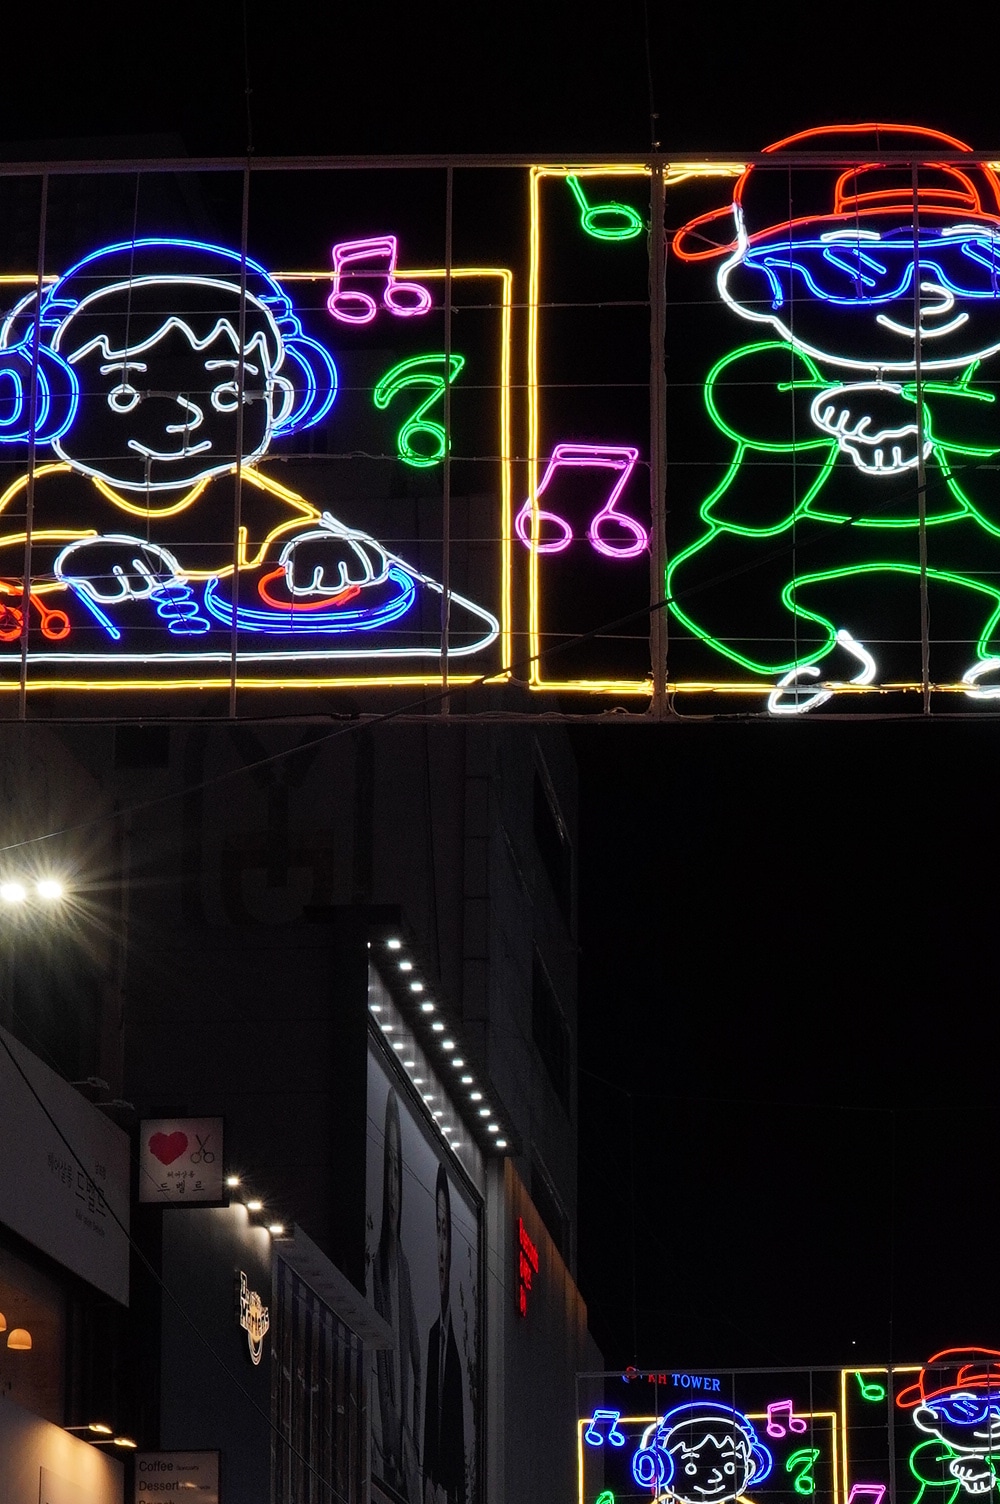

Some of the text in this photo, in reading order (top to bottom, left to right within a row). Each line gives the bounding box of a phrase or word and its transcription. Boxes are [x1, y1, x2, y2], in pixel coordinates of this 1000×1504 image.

[671, 1373, 721, 1392] TOWER
[139, 1461, 174, 1472] Coffee
[139, 1480, 179, 1491] Dessert
